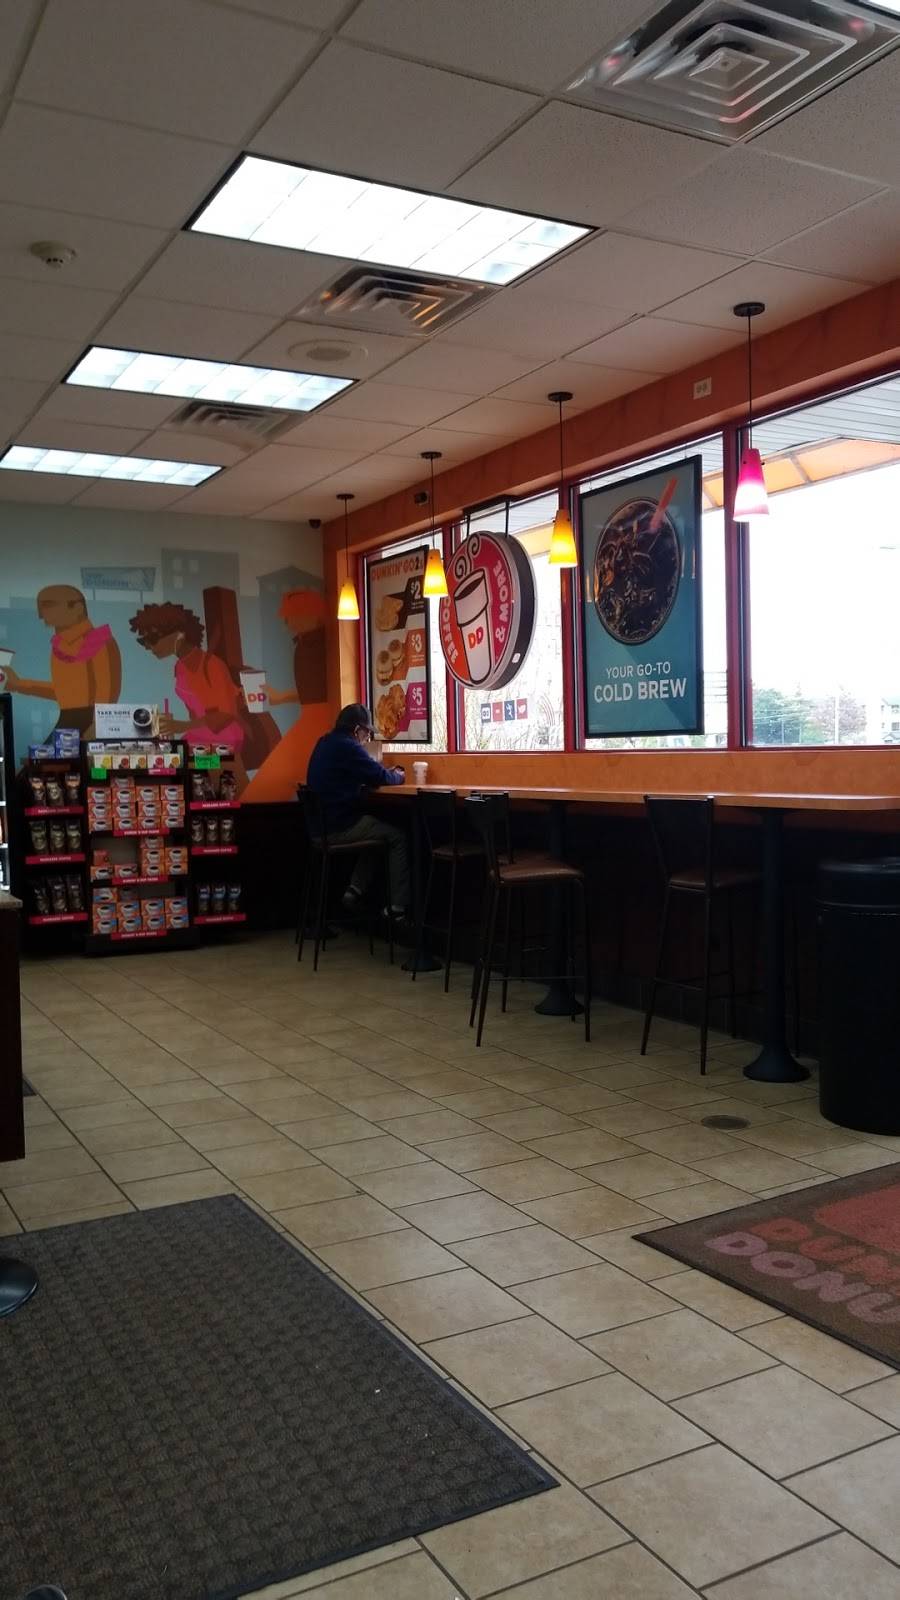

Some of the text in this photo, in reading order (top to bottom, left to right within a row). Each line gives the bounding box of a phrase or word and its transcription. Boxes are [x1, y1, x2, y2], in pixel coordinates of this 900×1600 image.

[410, 580, 421, 600] $2
[492, 559, 509, 623] MORE
[411, 633, 422, 652] $3
[467, 626, 484, 649] DD
[606, 661, 671, 679] YOUR GO-TO
[247, 692, 267, 703] DD
[412, 687, 423, 706] $5
[594, 678, 687, 703] COLD BREW
